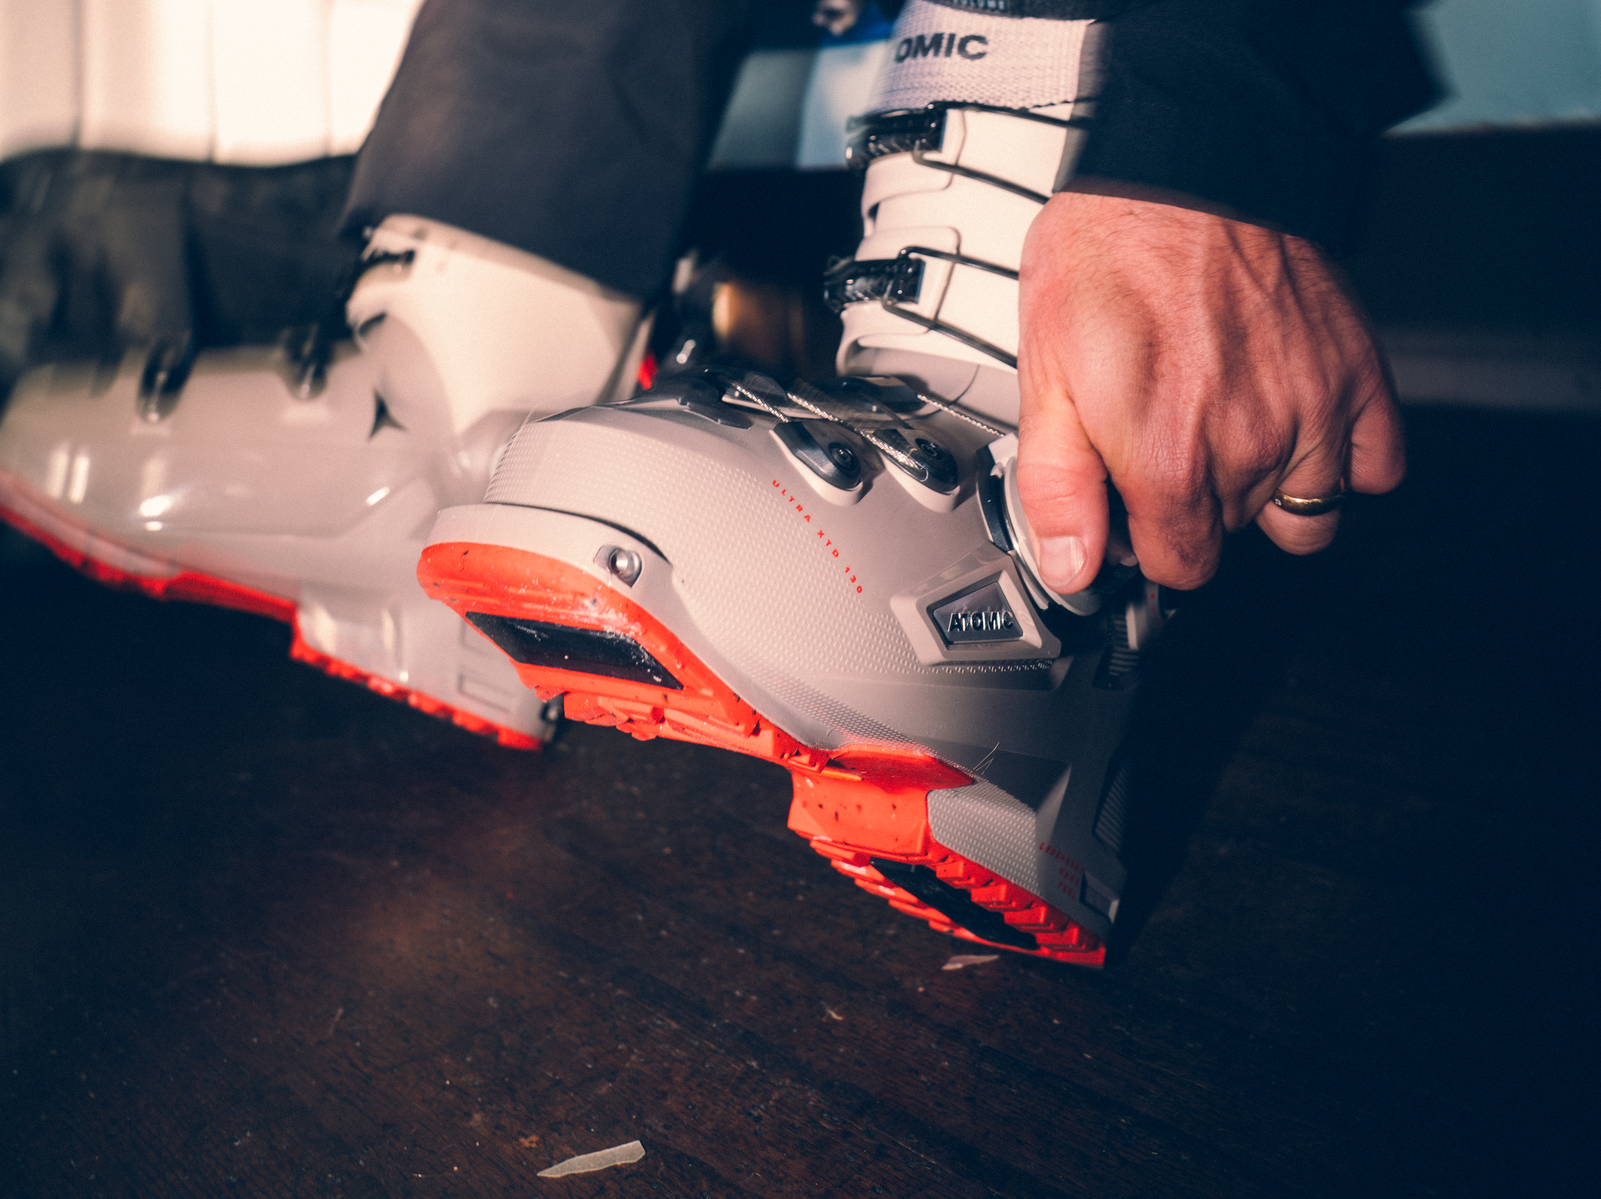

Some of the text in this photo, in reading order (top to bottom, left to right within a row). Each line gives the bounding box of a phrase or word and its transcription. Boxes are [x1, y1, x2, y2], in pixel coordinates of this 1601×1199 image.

[772, 480, 863, 593] ULTRA XTD 130
[948, 611, 1014, 633] ATOMIC
